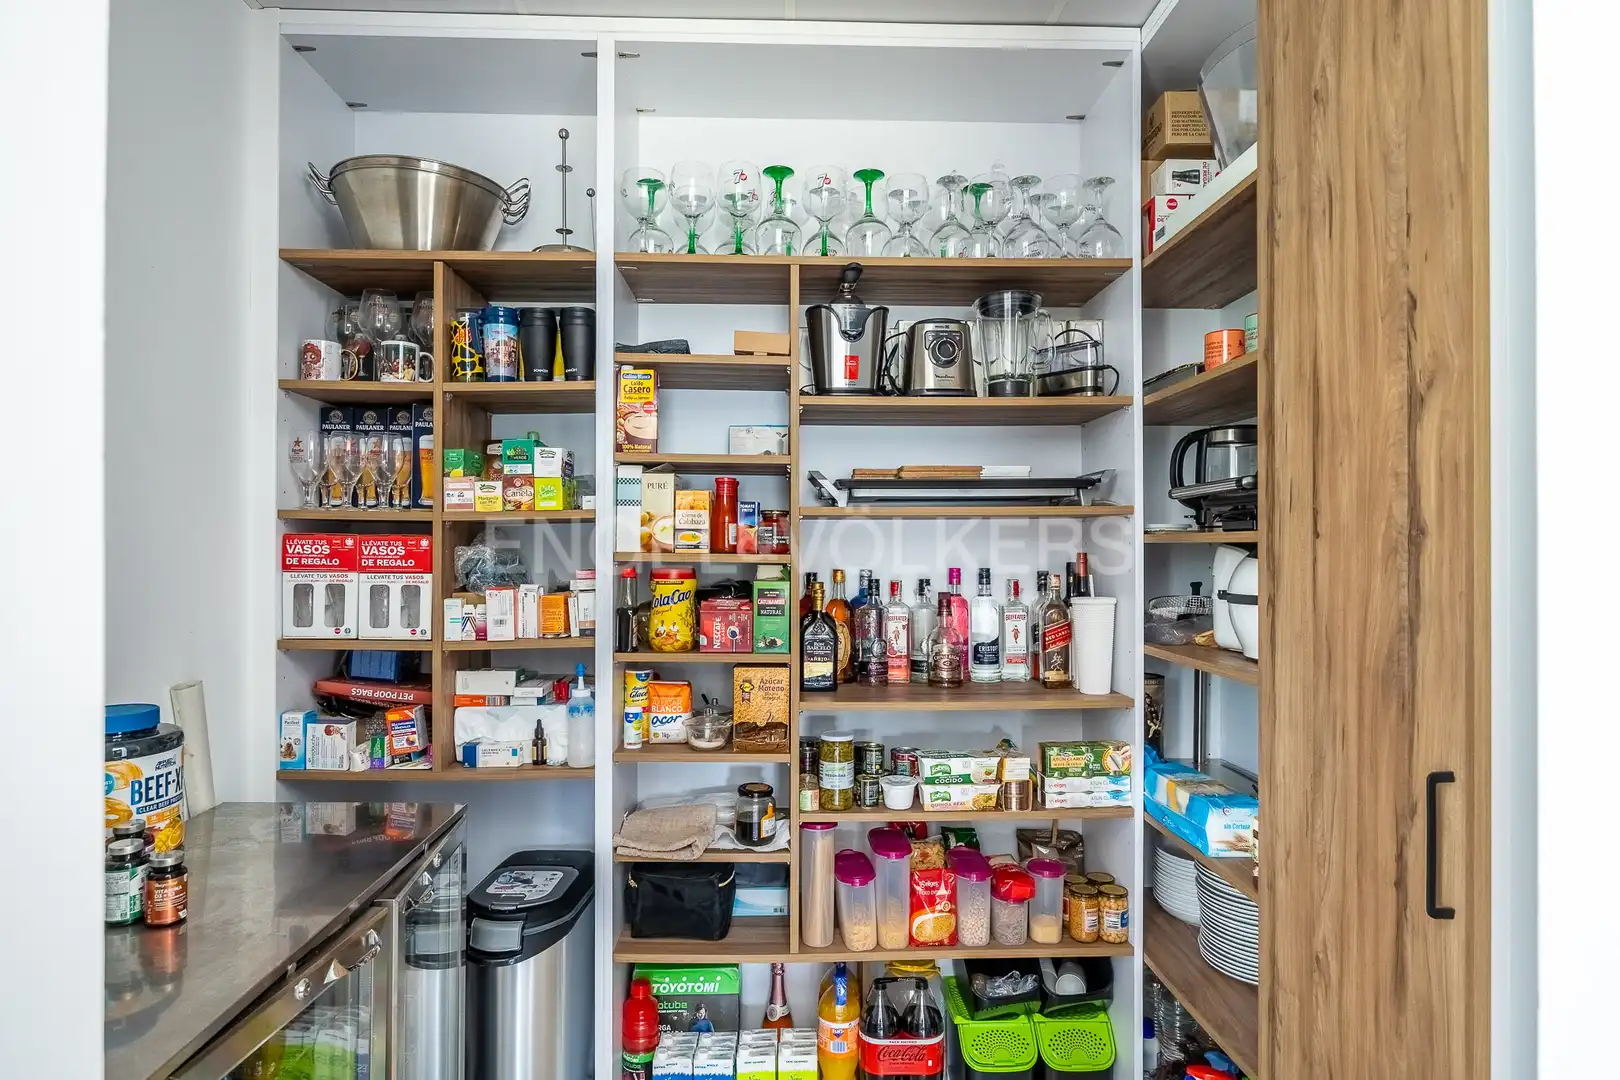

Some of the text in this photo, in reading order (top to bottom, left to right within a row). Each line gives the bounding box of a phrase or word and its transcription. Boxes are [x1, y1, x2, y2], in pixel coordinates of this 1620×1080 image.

[623, 385, 651, 393] Casero
[647, 480, 668, 490] PURÉ
[504, 489, 532, 497] Canela
[286, 545, 330, 554] VASOS
[362, 546, 406, 555] VASOS
[351, 688, 414, 700] PET POOP BAGS
[652, 715, 682, 728] acor
[140, 804, 157, 813] CLEAR
[158, 800, 170, 809] BEEF
[652, 978, 721, 994] TOYOTOMI
[658, 1001, 688, 1010] otube
[877, 1045, 928, 1062] Coca-Cola
